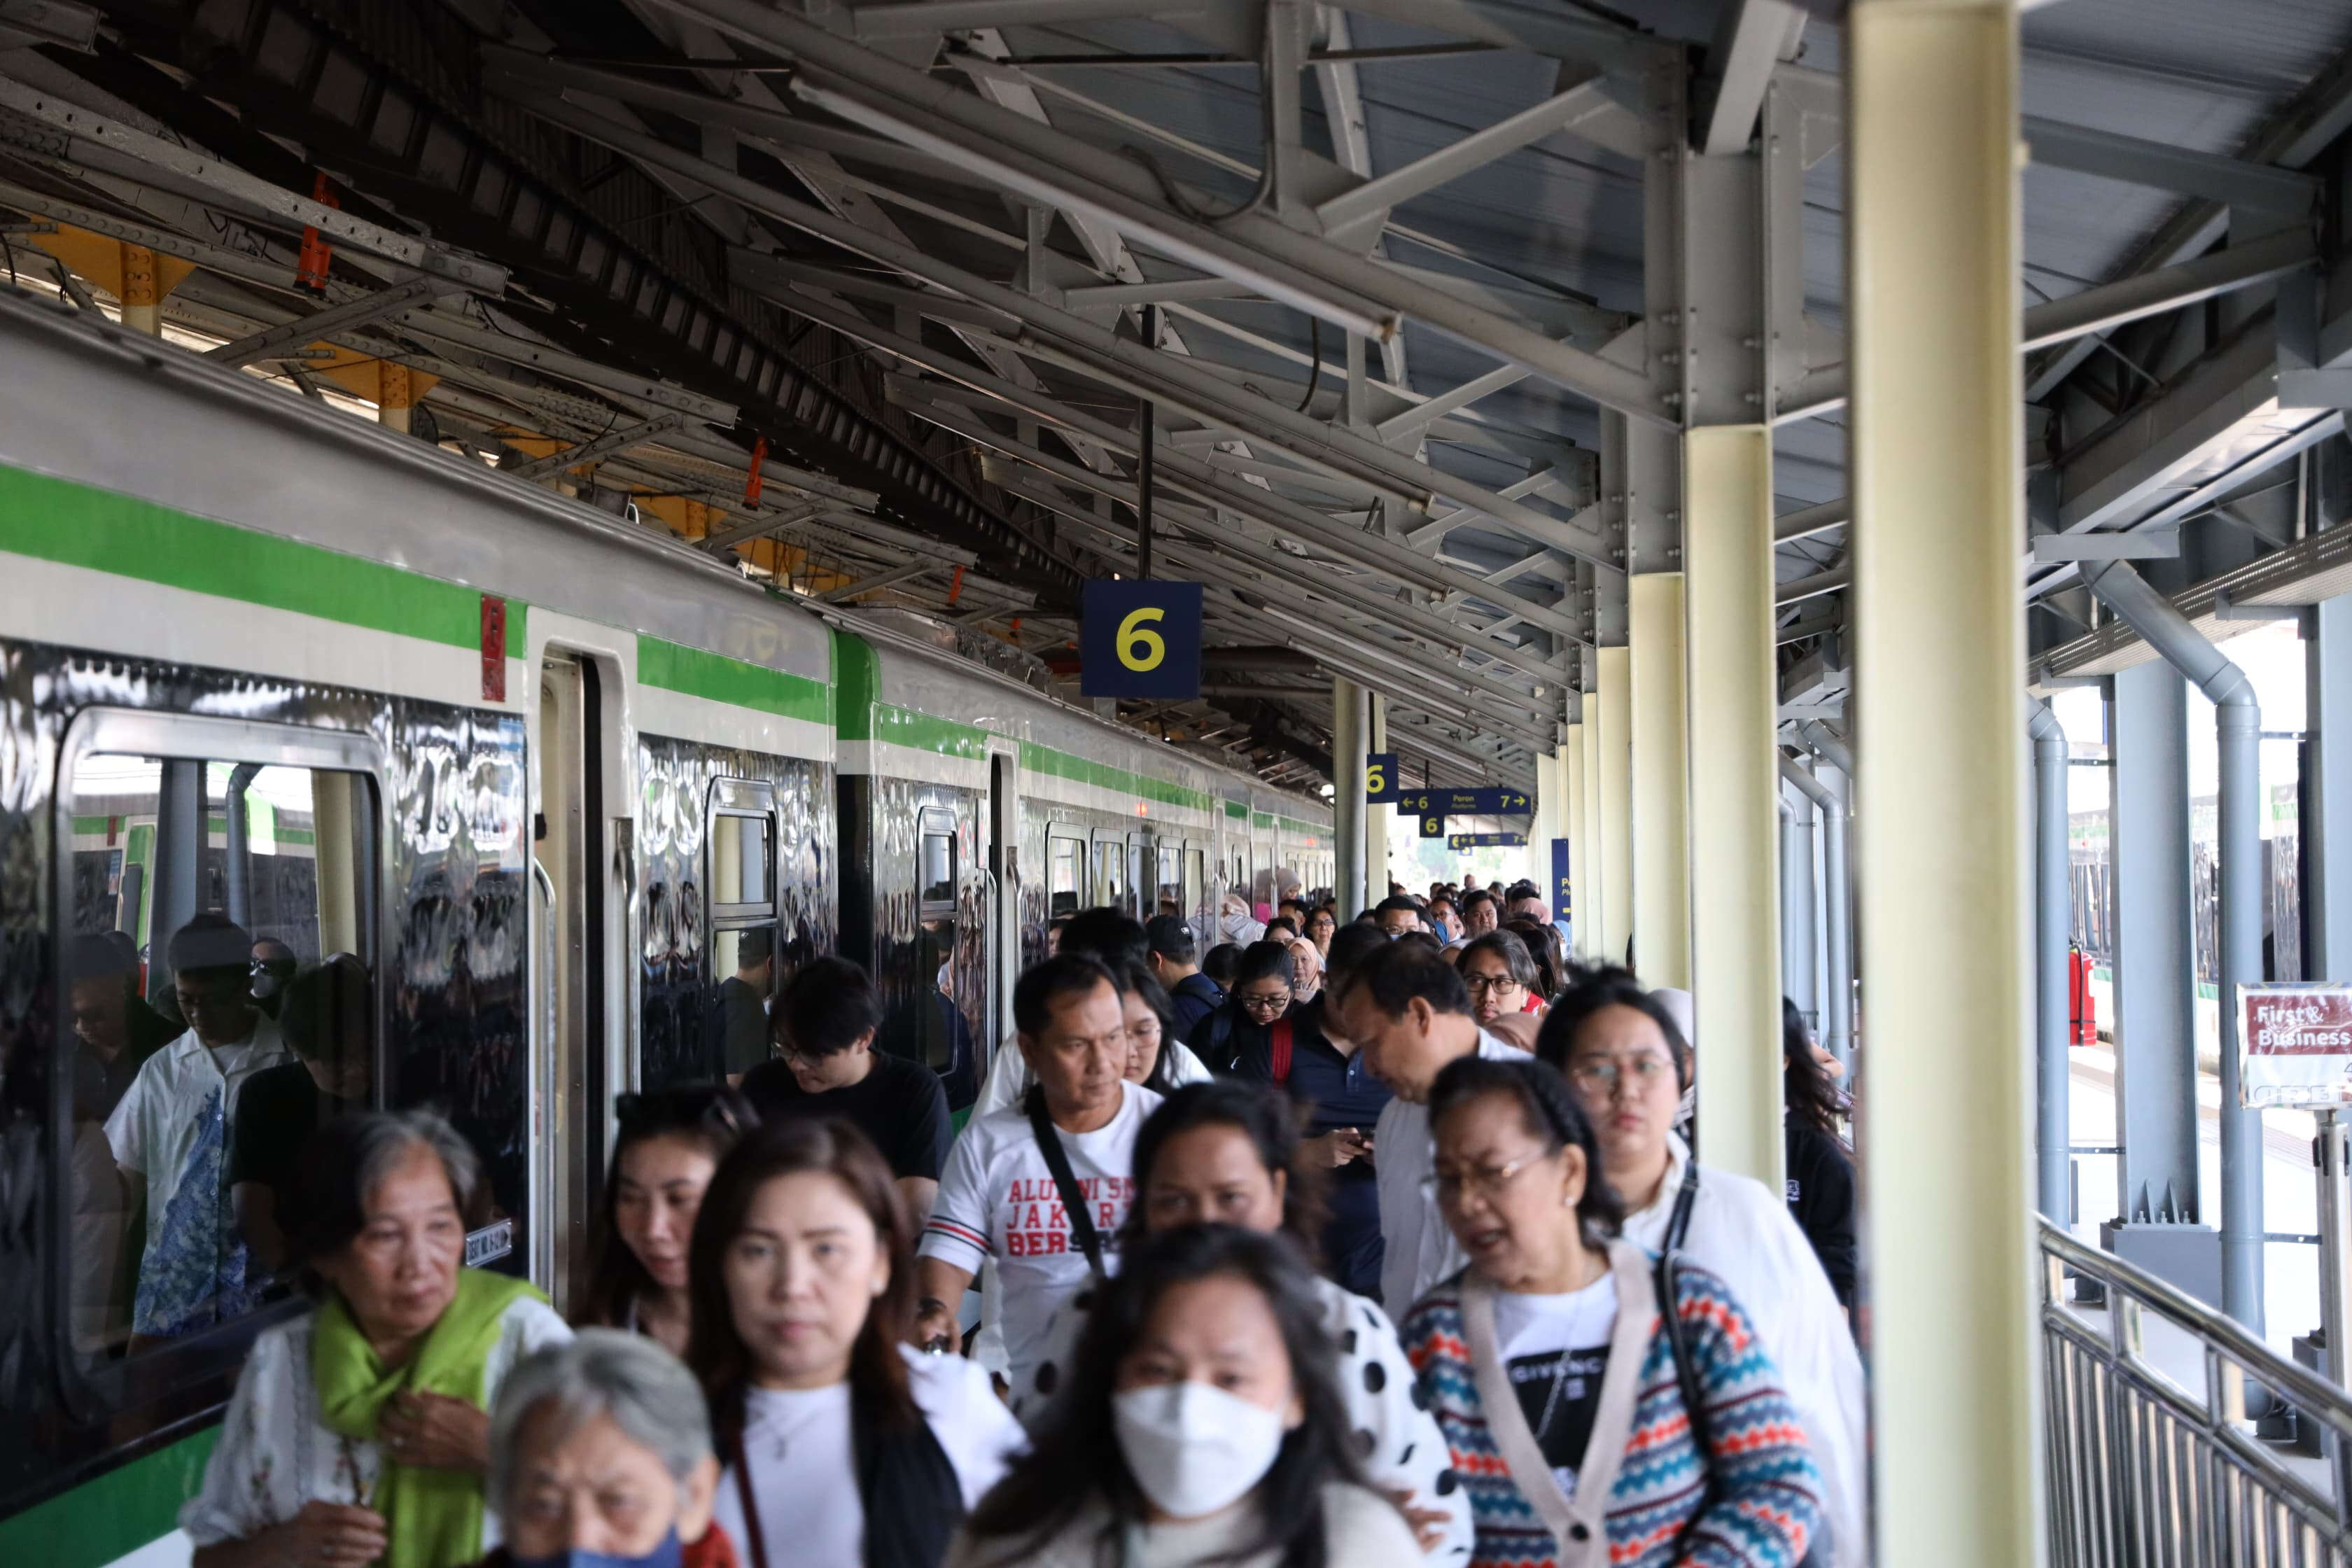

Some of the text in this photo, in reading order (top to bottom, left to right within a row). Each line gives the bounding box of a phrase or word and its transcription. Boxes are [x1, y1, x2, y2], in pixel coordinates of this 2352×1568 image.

[1116, 608, 1165, 672] 6
[1366, 765, 1385, 793] 6
[1418, 794, 1511, 810] 6 Peron 7
[1425, 818, 1438, 834] 6
[2258, 1030, 2352, 1046] Business
